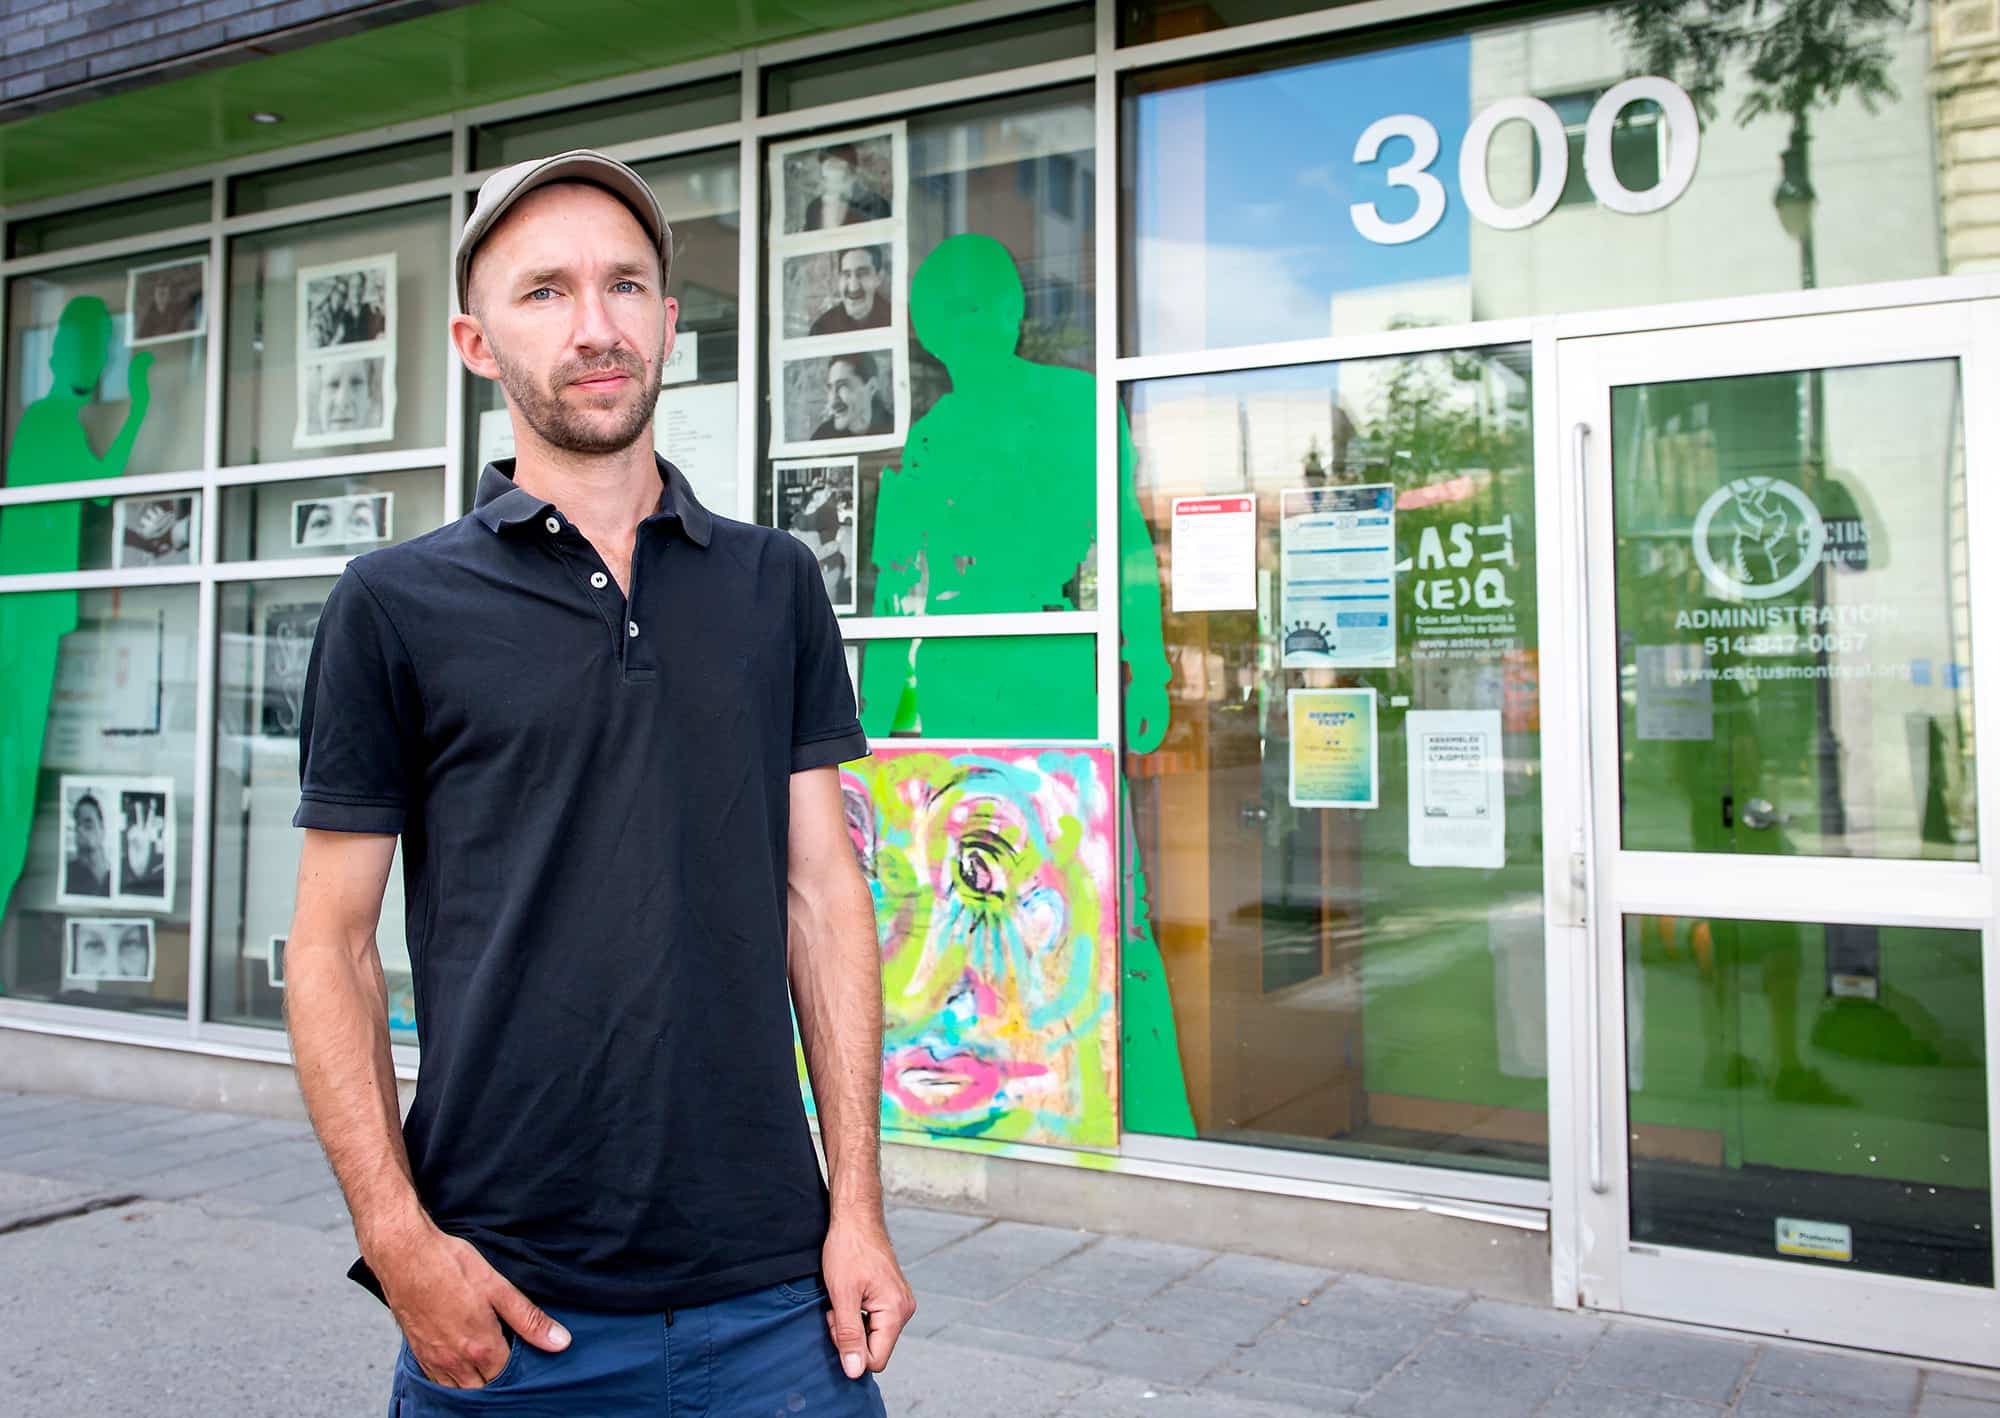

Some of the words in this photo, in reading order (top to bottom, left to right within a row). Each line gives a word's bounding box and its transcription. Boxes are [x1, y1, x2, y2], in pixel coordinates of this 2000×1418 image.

[1350, 75, 1701, 245] 300
[1414, 568, 1515, 610] (E)Q
[1675, 605, 1898, 628] ADMINISTRATION
[1675, 662, 1912, 681] www.cactusmontreal.org
